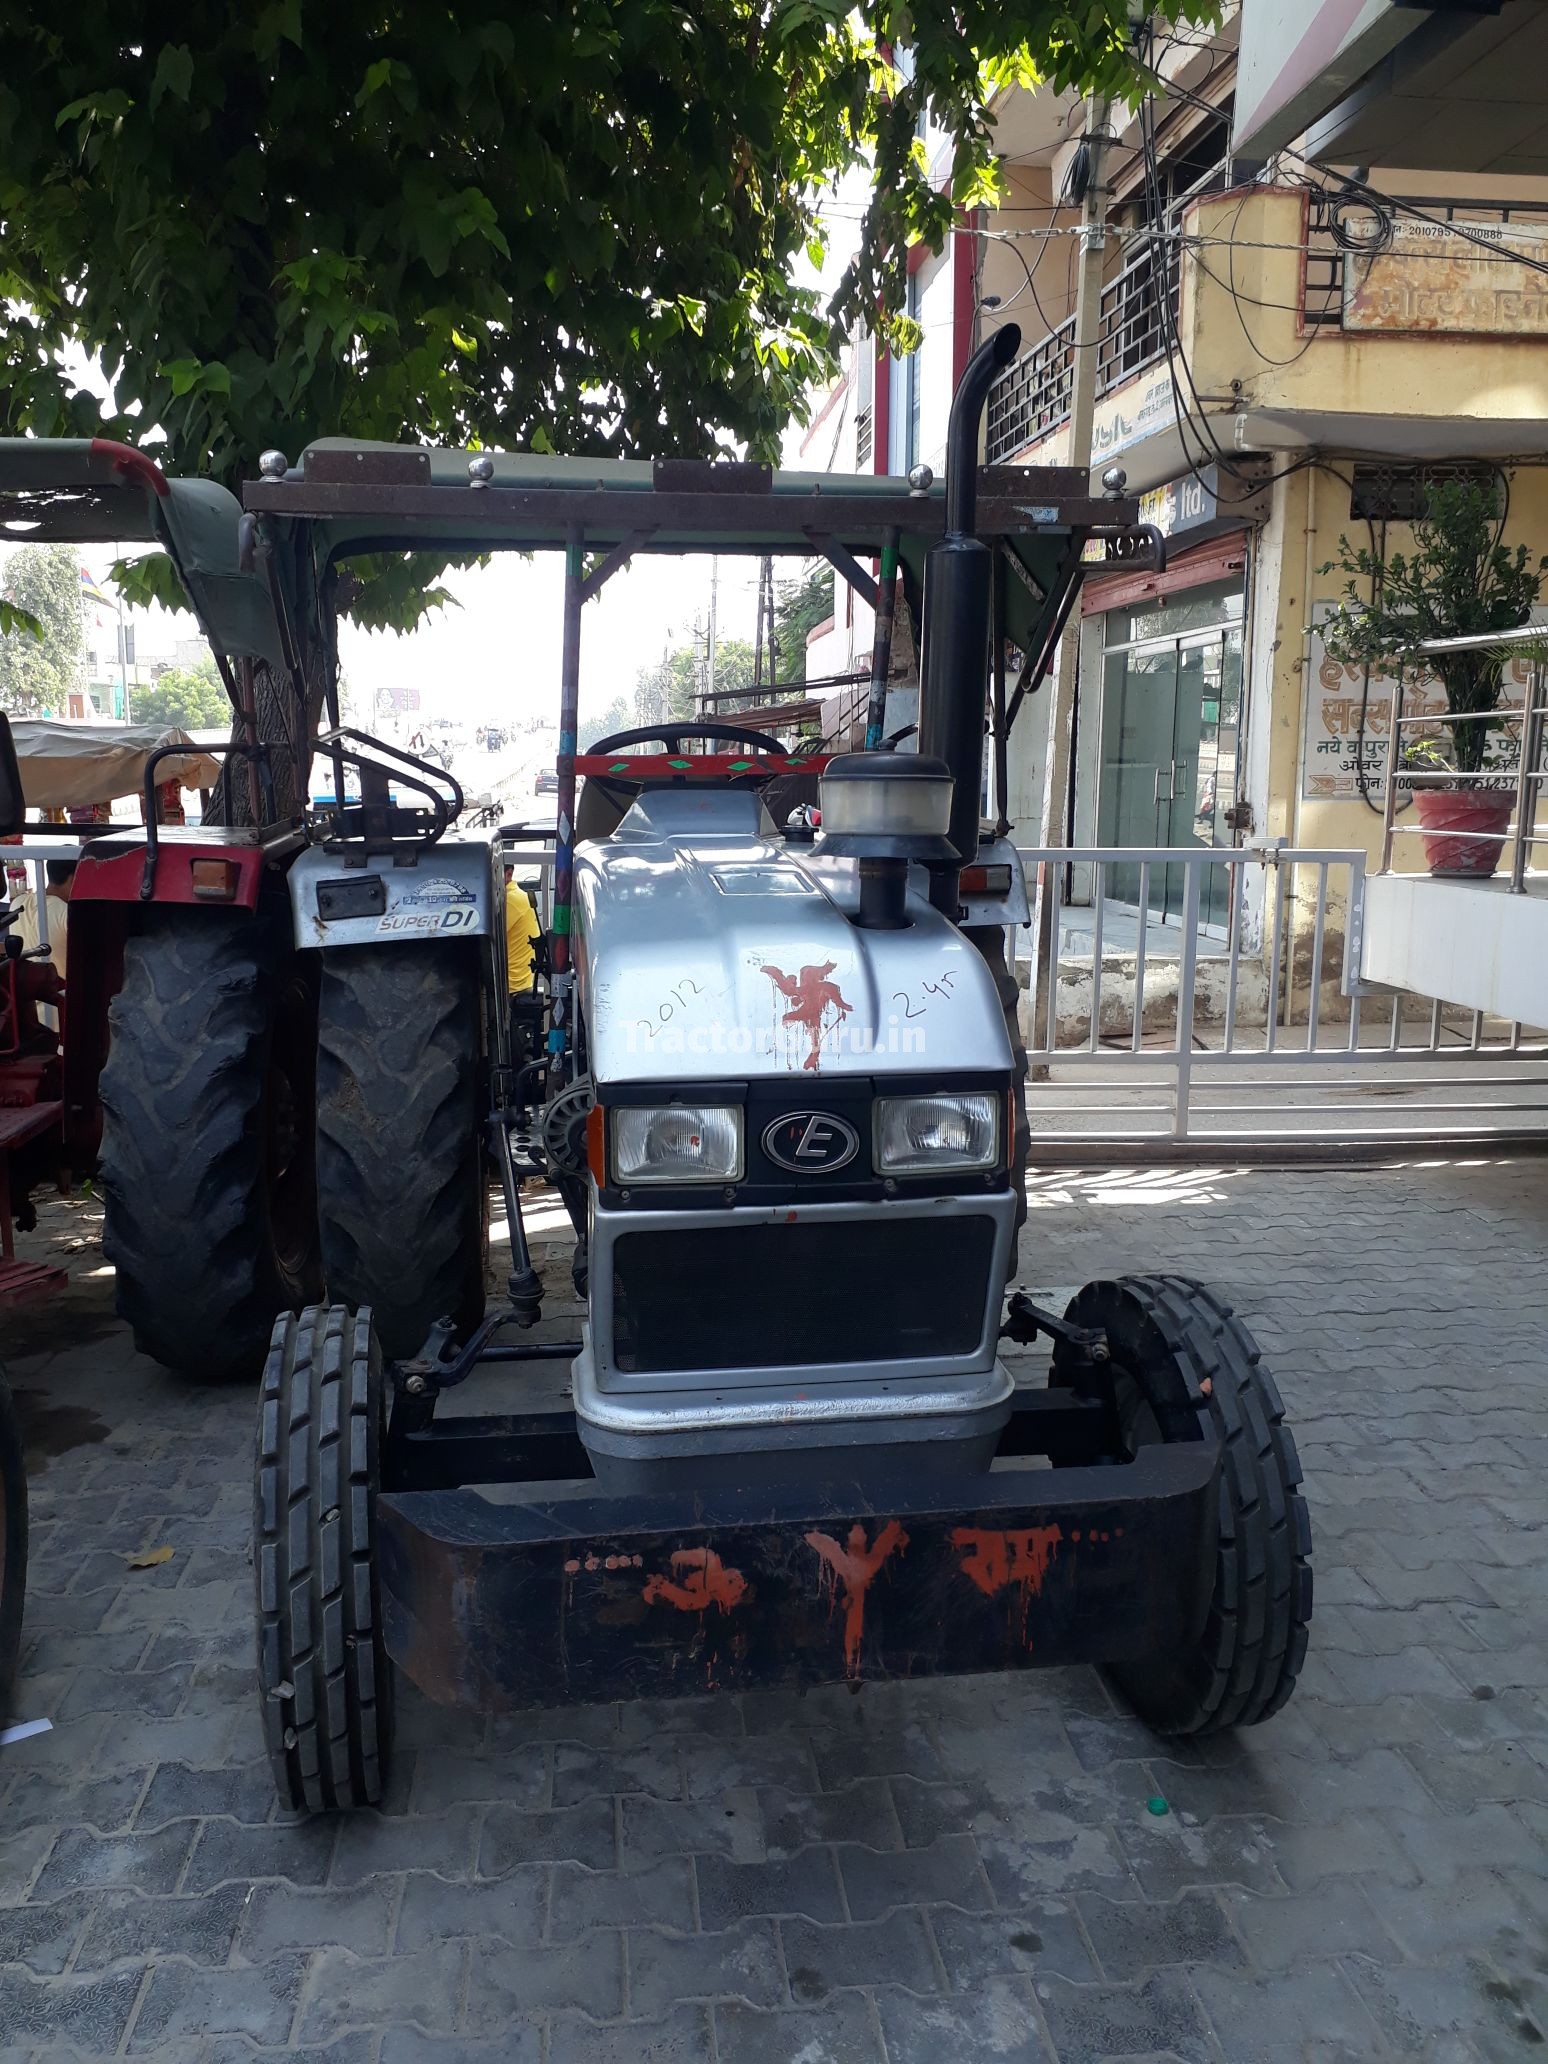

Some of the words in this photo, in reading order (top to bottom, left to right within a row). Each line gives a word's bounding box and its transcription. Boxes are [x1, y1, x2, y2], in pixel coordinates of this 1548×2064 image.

[1181, 481, 1205, 520] ltd.
[1317, 736, 1342, 754] नये
[379, 915, 440, 930] SUPER
[440, 910, 475, 929] DI
[636, 978, 706, 1038] 2012
